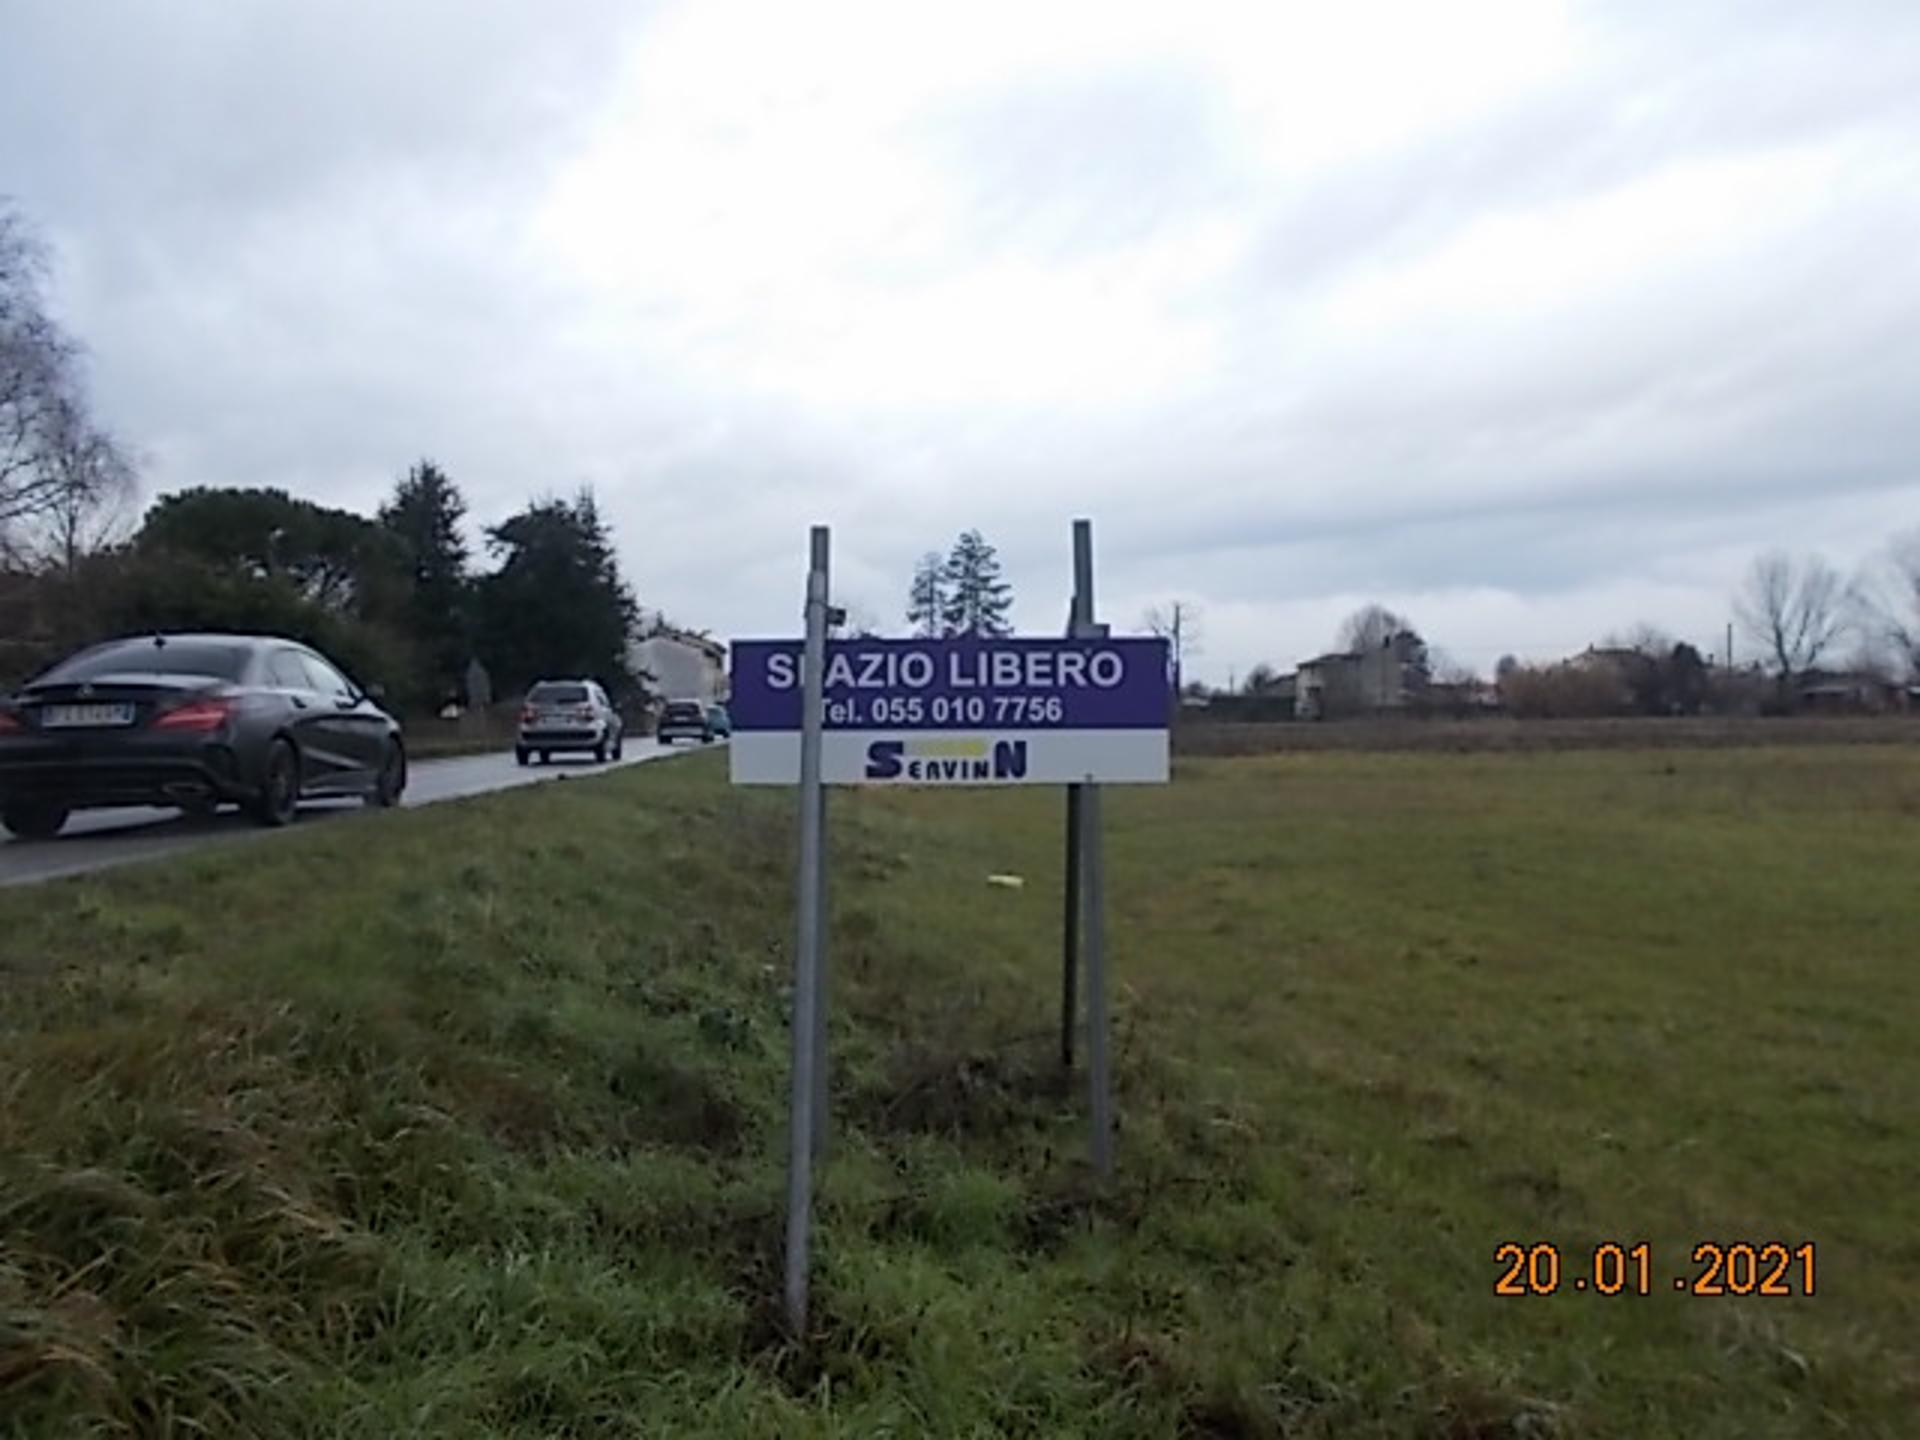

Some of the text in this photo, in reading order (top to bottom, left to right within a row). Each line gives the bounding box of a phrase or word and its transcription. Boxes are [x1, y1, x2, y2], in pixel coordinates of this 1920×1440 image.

[766, 651, 1124, 689] SAZIO LIBERO
[871, 697, 923, 723] 055
[932, 697, 984, 723] 010
[993, 696, 1063, 722] 7756
